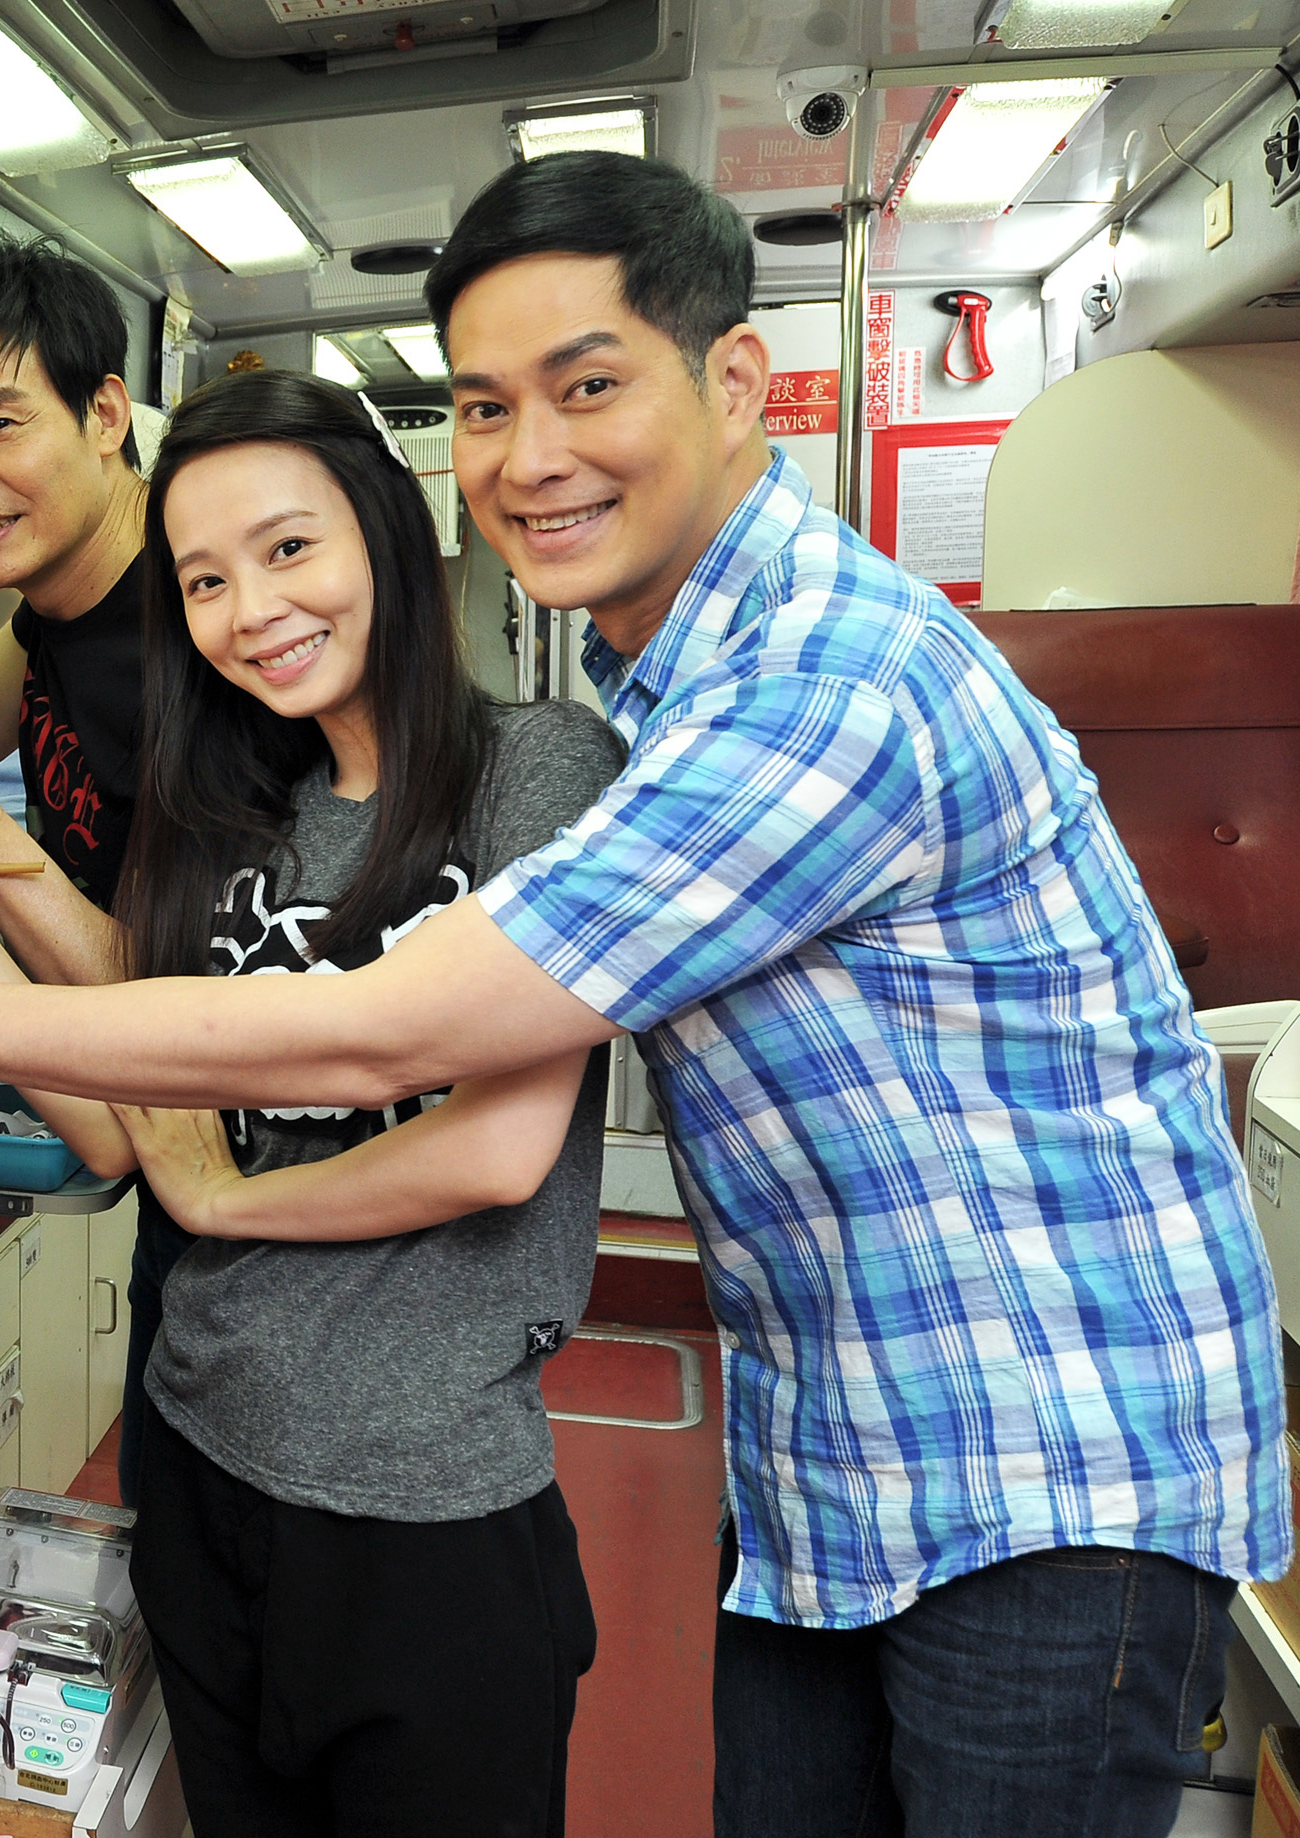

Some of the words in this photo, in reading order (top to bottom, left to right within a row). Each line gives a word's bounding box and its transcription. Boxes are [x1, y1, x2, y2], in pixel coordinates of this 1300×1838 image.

[866, 294, 892, 428] 車窗擊破裝置
[770, 375, 831, 402] 談室
[766, 408, 822, 431] erview
[39, 1716, 51, 1725] 250
[63, 1722, 75, 1730] 500
